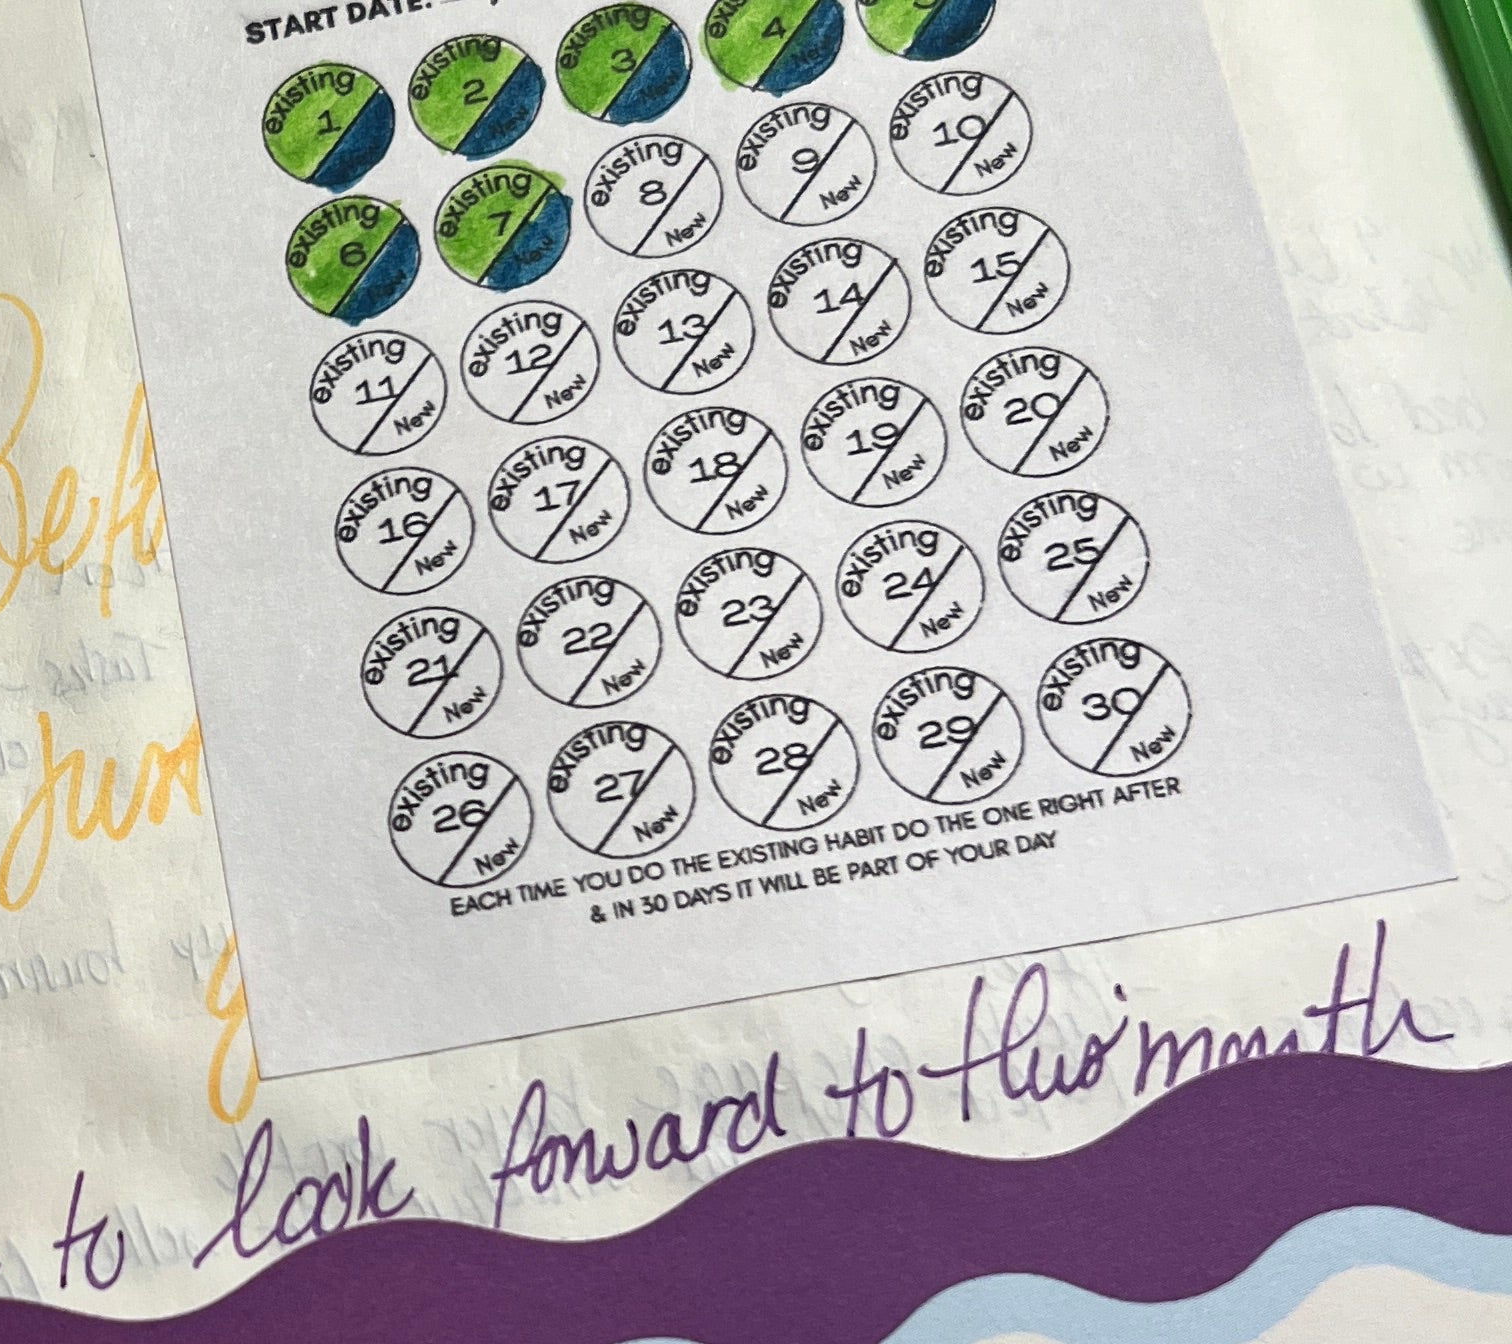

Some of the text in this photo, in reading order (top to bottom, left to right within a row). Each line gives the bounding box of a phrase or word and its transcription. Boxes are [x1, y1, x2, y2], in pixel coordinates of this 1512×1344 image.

[245, 6, 339, 45] START
[559, 3, 652, 70] existing
[760, 16, 787, 40] 4
[410, 34, 501, 102] existing
[610, 48, 637, 73] 3
[265, 69, 357, 136] existing
[462, 79, 488, 106] 2
[889, 71, 984, 141] existing
[317, 110, 341, 136] 1
[738, 104, 832, 172] existing
[932, 114, 988, 146] 10
[590, 138, 685, 207] existing
[792, 147, 822, 174] 9
[973, 142, 1017, 178] New
[438, 169, 532, 238] existing
[639, 180, 668, 206] 8
[819, 175, 862, 210] New
[289, 200, 383, 270] existing
[488, 212, 513, 237] 7
[664, 211, 707, 247] New
[339, 241, 368, 268] 6
[925, 210, 1020, 279] existing
[769, 240, 863, 310] existing
[970, 252, 1023, 283] 15
[616, 269, 711, 337] existing
[813, 283, 865, 315] 14
[1005, 282, 1049, 318] New
[468, 309, 564, 378] existing
[657, 314, 707, 345] 13
[849, 320, 893, 356] New
[312, 336, 406, 406] existing
[505, 344, 553, 375] 12
[692, 342, 736, 378] New
[354, 376, 400, 406] 11
[544, 374, 587, 409] New
[963, 352, 1062, 421] existing
[393, 401, 437, 436] New
[803, 383, 901, 452] existing
[1004, 393, 1062, 426] 20
[651, 408, 747, 476] existing
[846, 423, 900, 456] 19
[1049, 426, 1094, 462] New
[489, 445, 587, 512] existing
[688, 451, 742, 484] 18
[882, 453, 927, 489] New
[338, 474, 433, 544] existing
[534, 480, 581, 512] 17
[725, 484, 769, 520] New
[378, 512, 429, 544] 16
[569, 509, 613, 544] New
[1000, 493, 1099, 563] existing
[415, 539, 459, 576] New
[841, 529, 939, 598] existing
[1044, 537, 1102, 571] 25
[677, 550, 775, 619] existing
[882, 567, 937, 600] 24
[1087, 574, 1134, 611] New
[518, 579, 614, 648] existing
[722, 595, 776, 627] 23
[919, 602, 965, 638] New
[364, 617, 461, 686] existing
[562, 623, 614, 656] 22
[759, 632, 804, 669] New
[406, 656, 459, 687] 21
[601, 658, 646, 696] New
[1041, 640, 1141, 711] existing
[442, 686, 488, 723] New
[876, 671, 976, 741] existing
[1082, 687, 1142, 721] 30
[710, 695, 811, 765] existing
[917, 715, 978, 750] 29
[1129, 725, 1176, 762] New
[548, 722, 648, 794] existing
[754, 743, 812, 776] 28
[960, 750, 1007, 788] New
[392, 761, 489, 833] existing
[593, 769, 648, 802] 27
[796, 779, 842, 815] New
[432, 799, 487, 834] 26
[631, 804, 679, 843] New
[450, 777, 1181, 917] EACH TIME YOU DO THE EXISTING HABIT DO THE ONE RIGHT AFTER
[473, 837, 520, 876] New
[590, 830, 1058, 924] & IN 30 DAYS IT WILL BE PART OF YOUR DAY
[55, 1171, 128, 1290] to
[194, 1117, 415, 1270] look
[489, 1049, 785, 1229] forward
[824, 1026, 914, 1139] to
